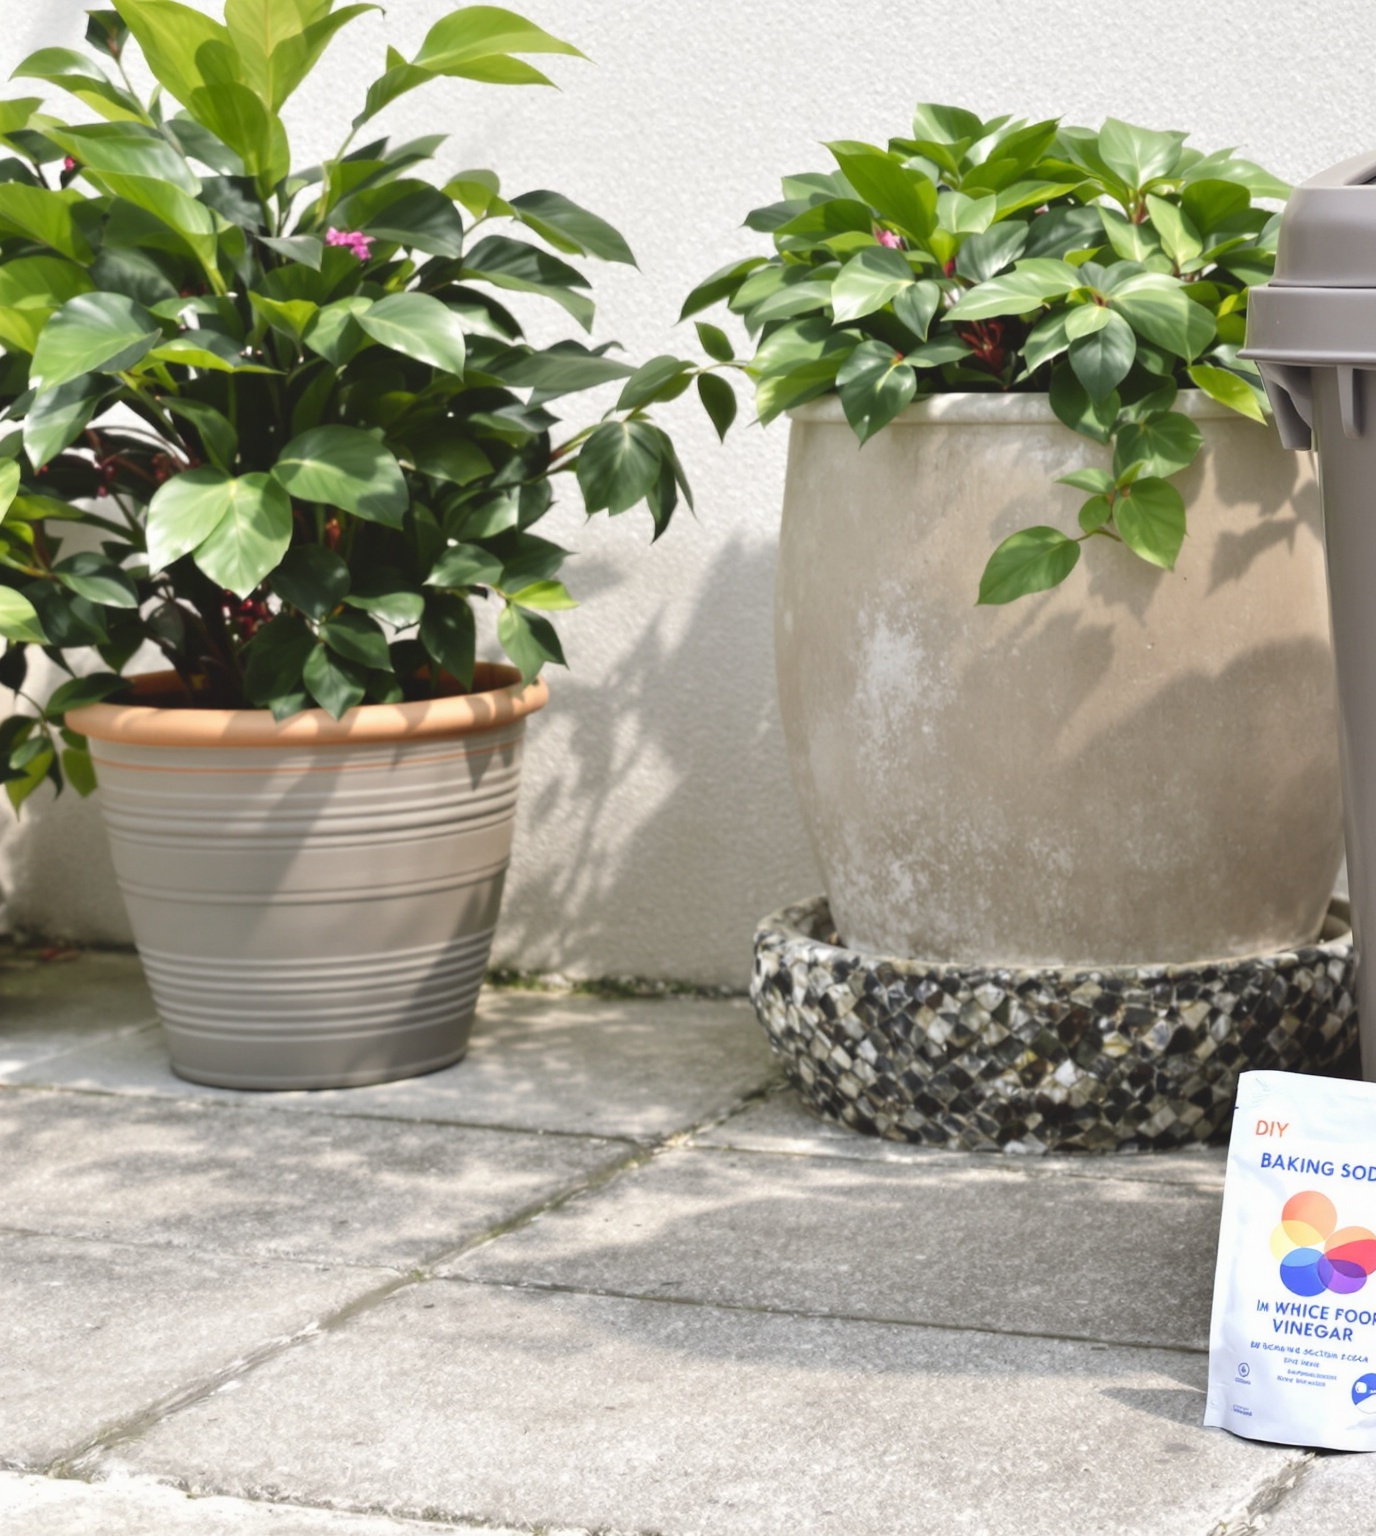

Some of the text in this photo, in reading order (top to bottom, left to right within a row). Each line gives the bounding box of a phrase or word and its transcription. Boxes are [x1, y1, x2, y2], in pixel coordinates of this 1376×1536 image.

[1255, 1120, 1289, 1137] DIY
[1261, 1152, 1334, 1176] BAKING
[1275, 1301, 1330, 1320] WHICE
[1273, 1318, 1353, 1342] VINEGAR
